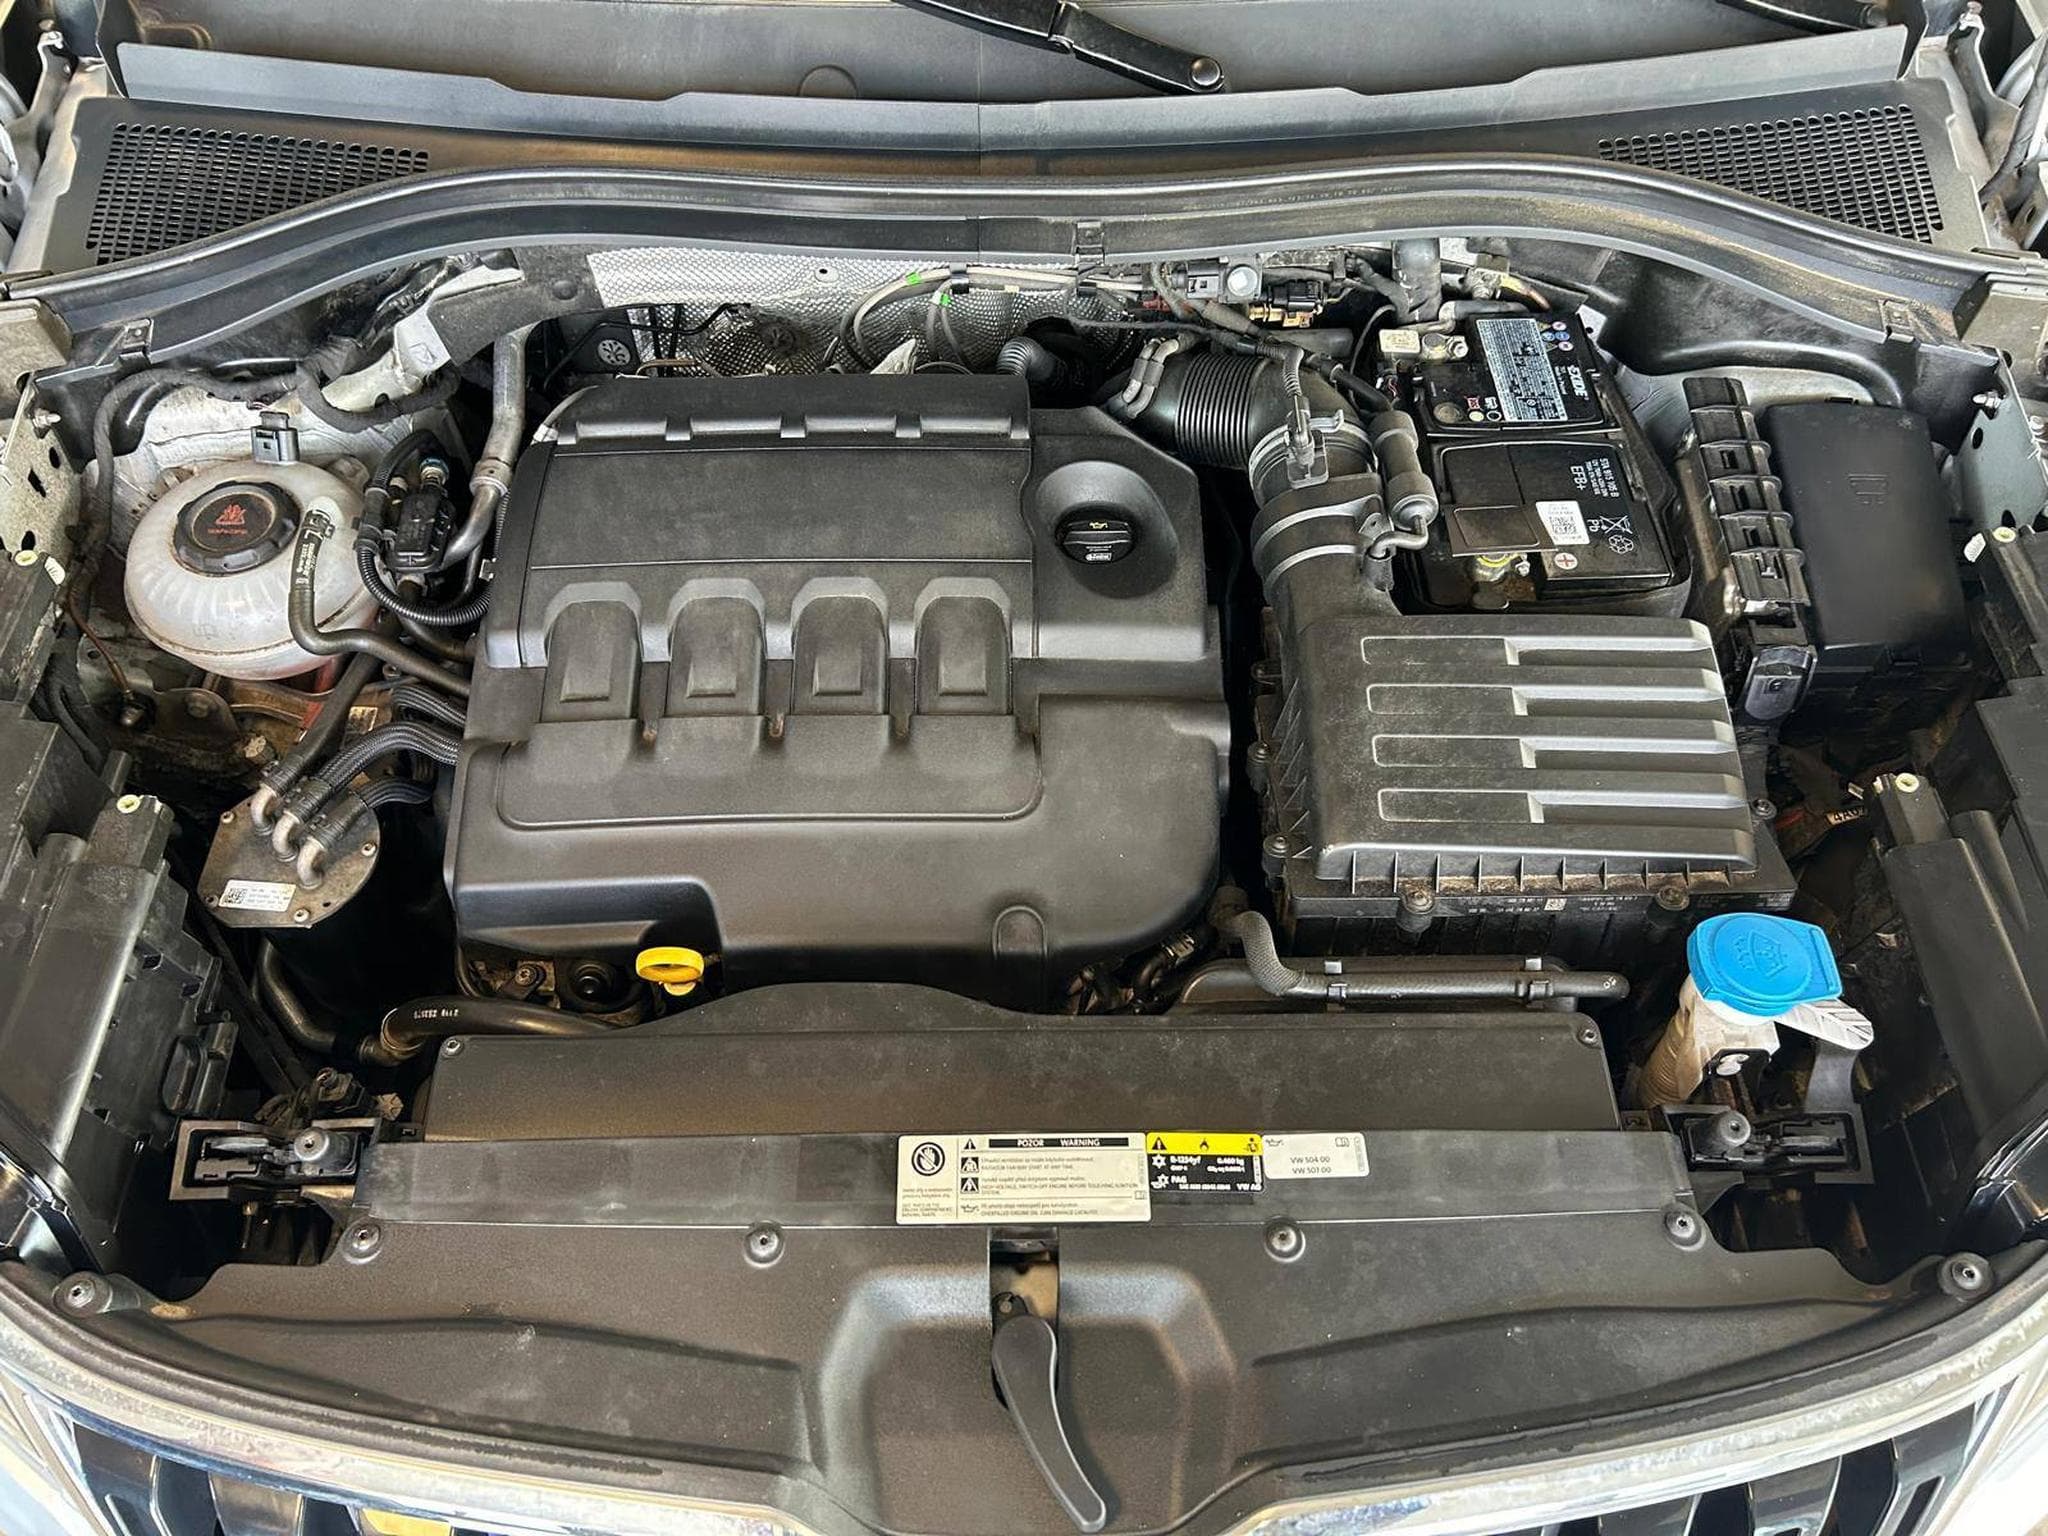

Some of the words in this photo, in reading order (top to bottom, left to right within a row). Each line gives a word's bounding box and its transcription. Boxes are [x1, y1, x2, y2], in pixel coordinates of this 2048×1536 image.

[1571, 465, 1588, 490] EFB+
[1587, 519, 1600, 532] Pb
[1017, 1138, 1044, 1147] POZOR
[1060, 1138, 1100, 1147] WARNING
[1170, 1175, 1188, 1184] PAG
